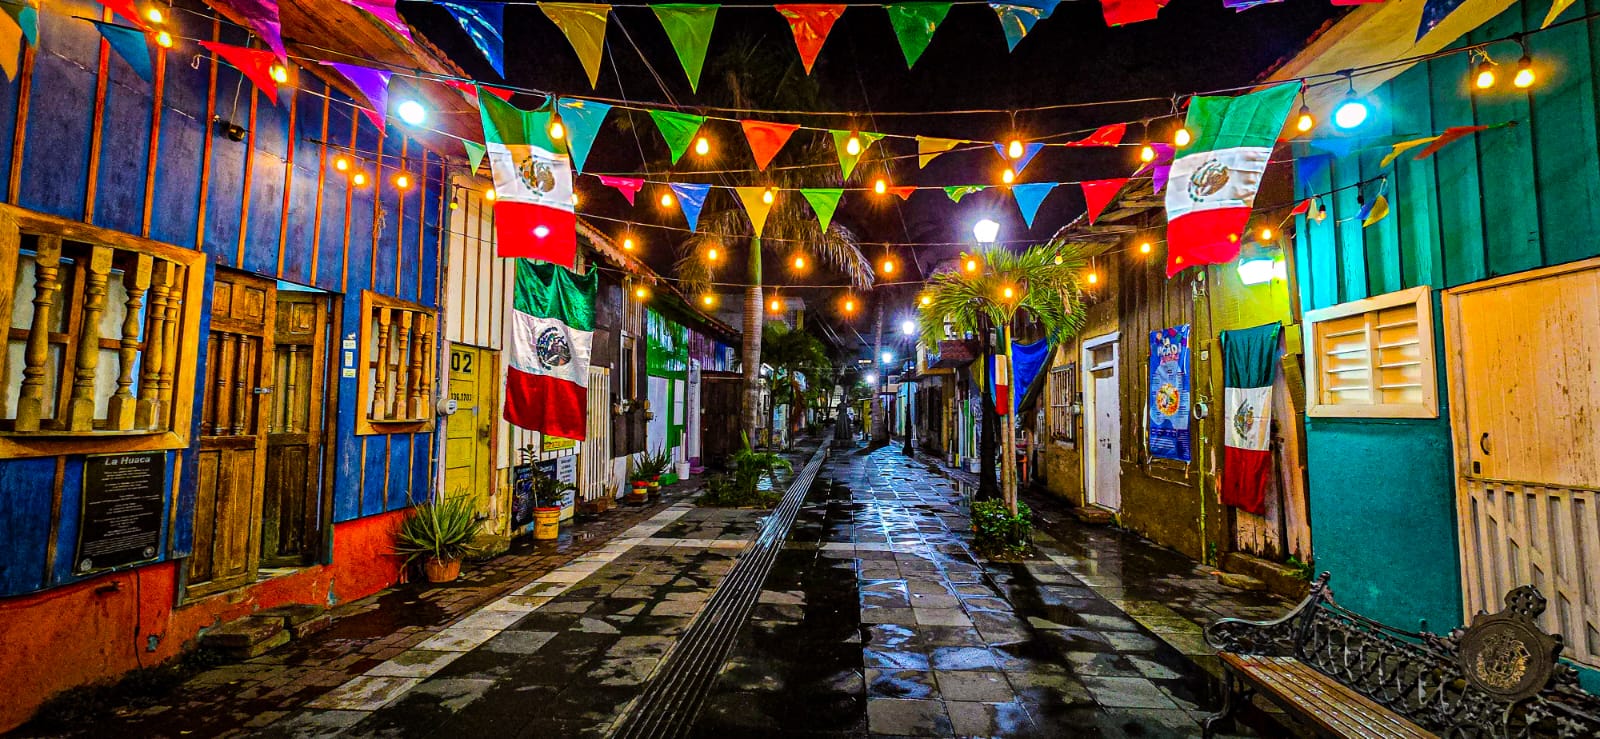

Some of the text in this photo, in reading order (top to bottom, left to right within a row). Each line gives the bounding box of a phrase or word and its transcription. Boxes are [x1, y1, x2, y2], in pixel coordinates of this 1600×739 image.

[451, 352, 472, 373] 02
[105, 456, 151, 466] La Huaca
